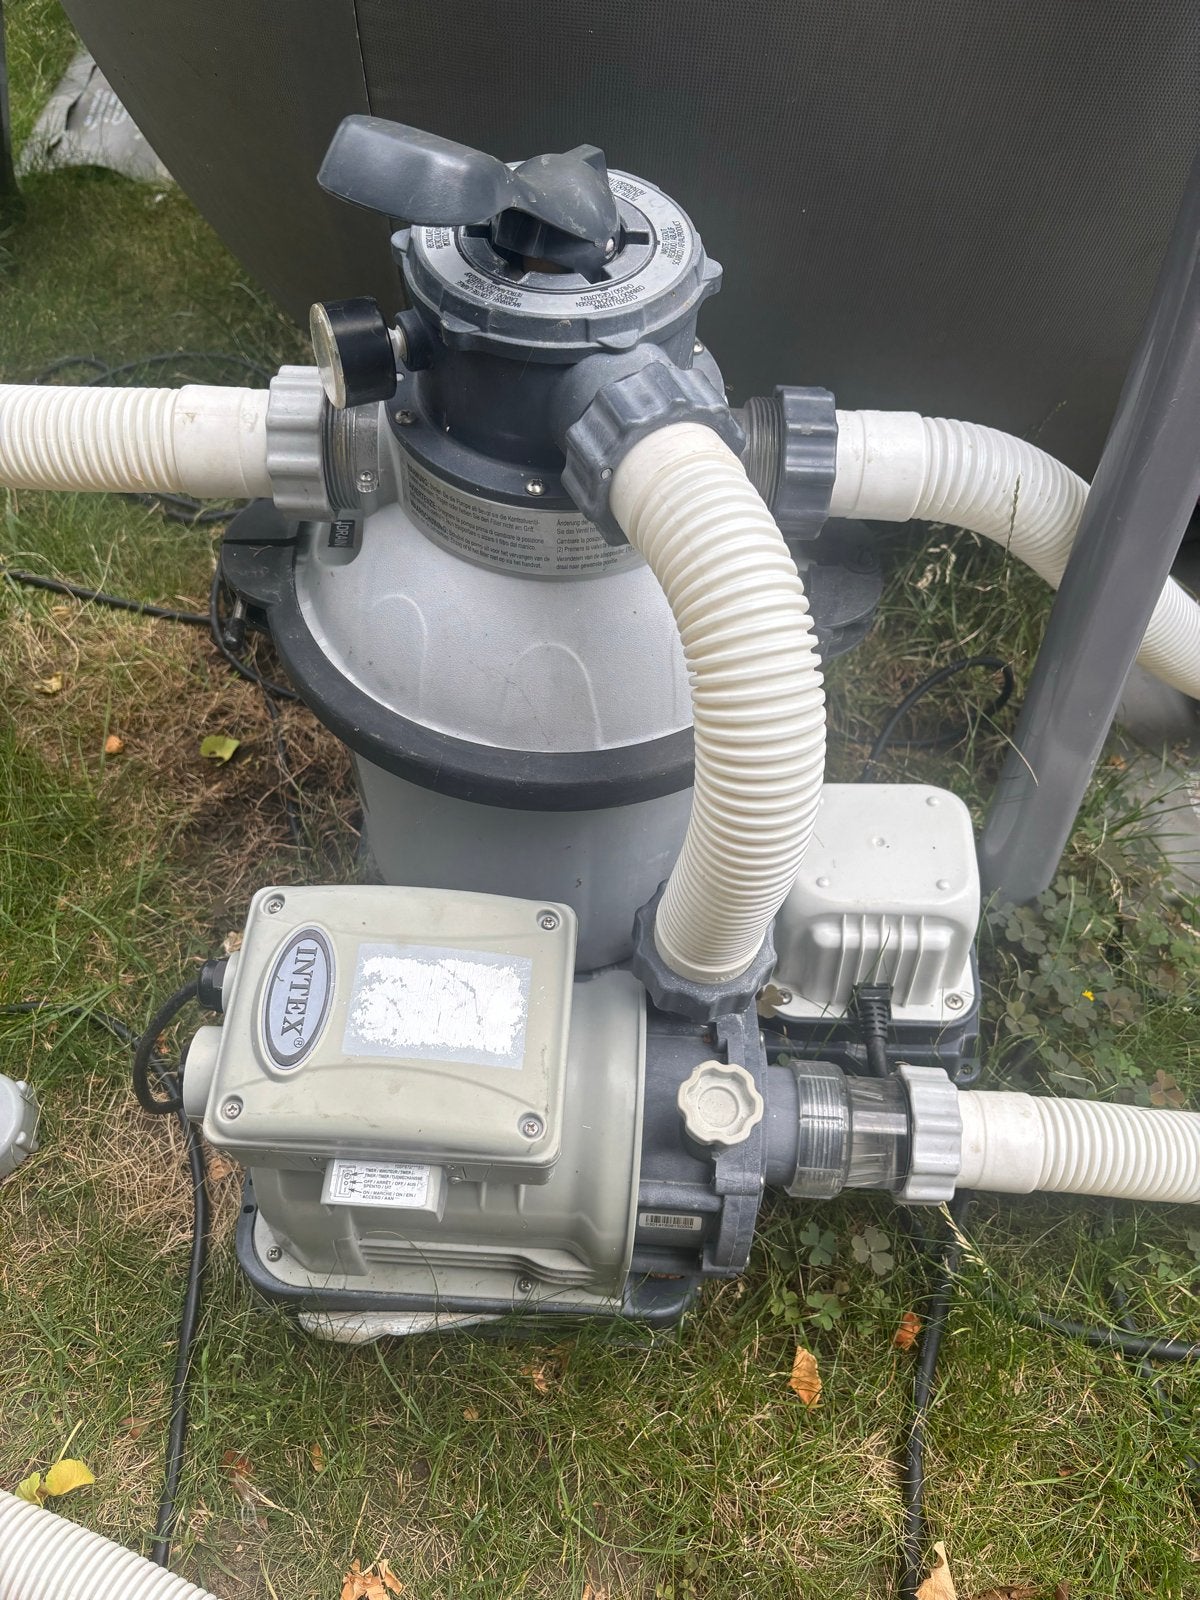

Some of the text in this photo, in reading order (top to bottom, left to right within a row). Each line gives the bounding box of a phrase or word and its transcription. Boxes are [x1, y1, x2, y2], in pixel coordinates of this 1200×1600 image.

[497, 293, 518, 302] LAVADO
[580, 292, 611, 301] GESLOTEN
[620, 285, 645, 299] CERRADO
[493, 297, 522, 308] BACKWASH
[575, 296, 618, 307] GESCHLOSSEN
[615, 295, 638, 306] CLOSED
[556, 554, 583, 562] Veranderen
